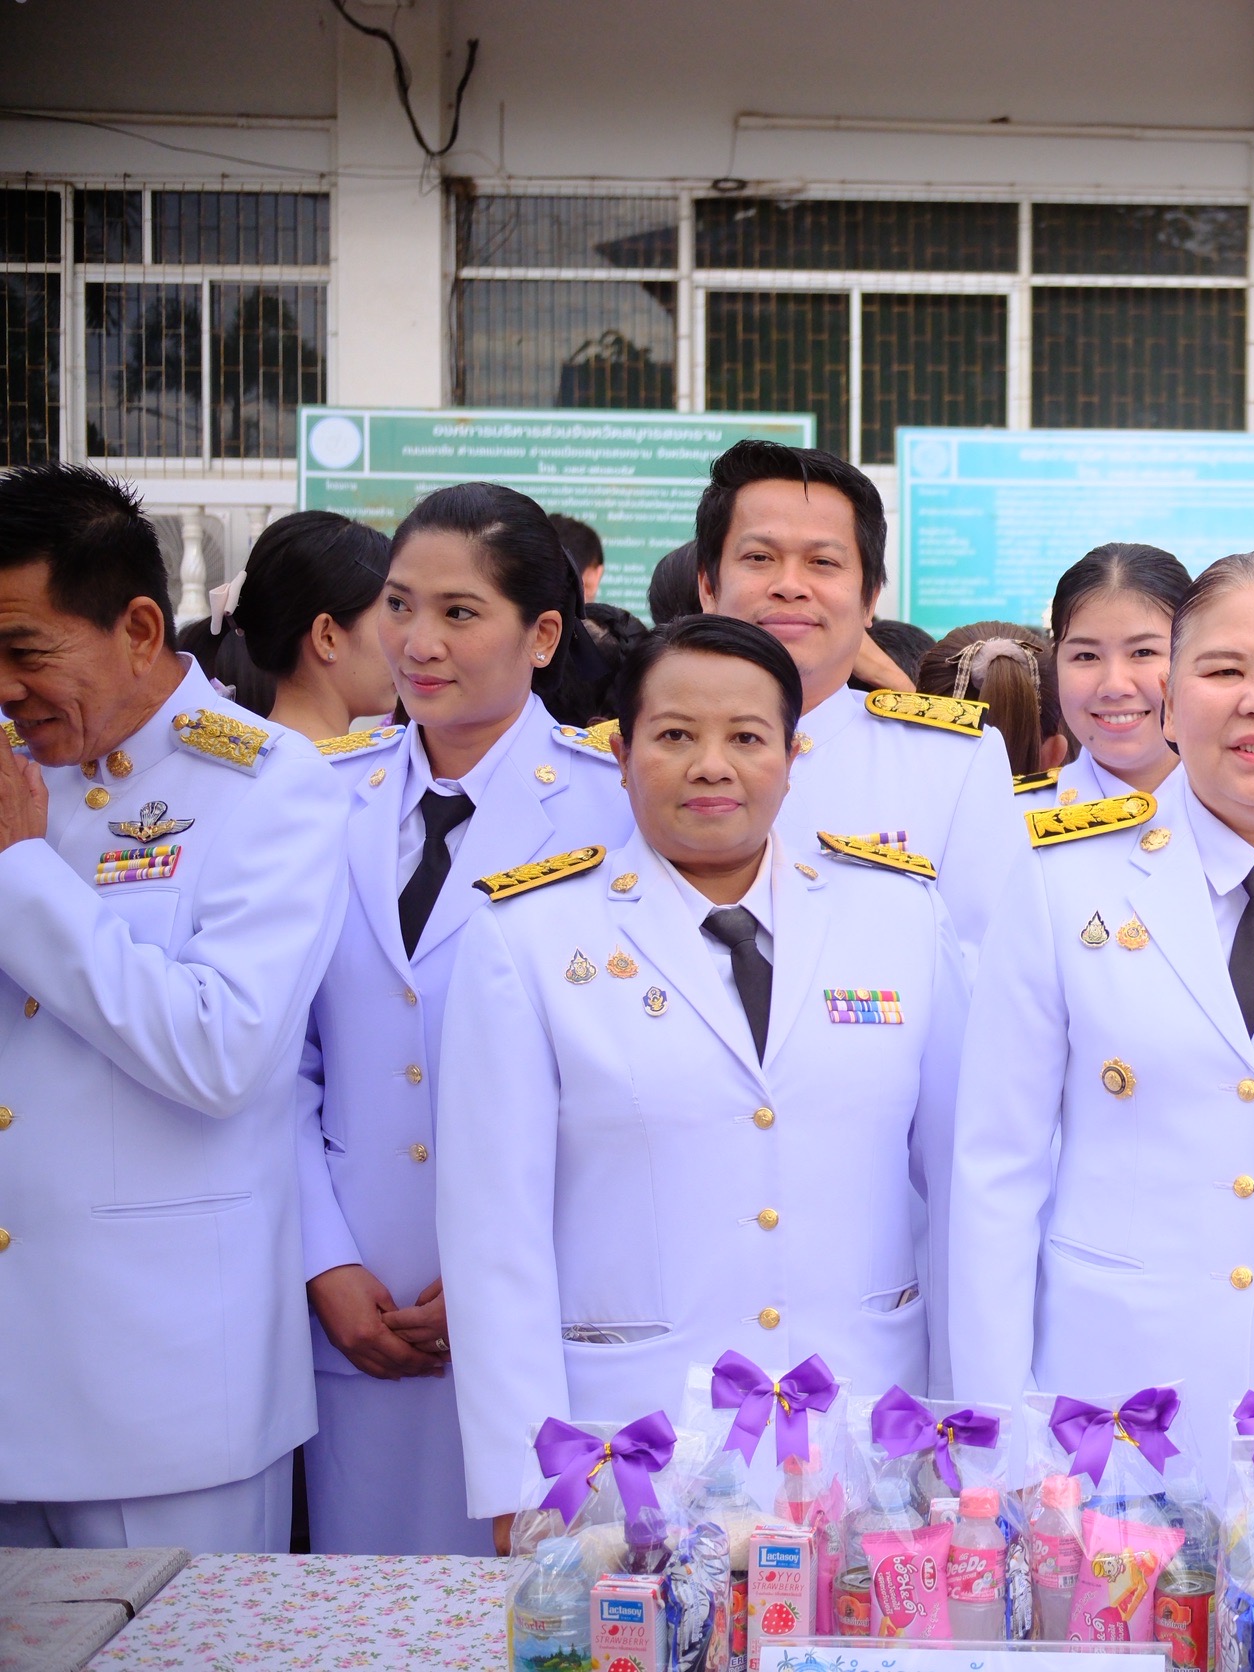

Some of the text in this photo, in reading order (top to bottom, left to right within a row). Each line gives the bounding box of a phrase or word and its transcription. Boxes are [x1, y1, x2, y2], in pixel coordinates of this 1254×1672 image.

[760, 1548, 799, 1565] Lactasoy
[752, 1582, 805, 1592] STRAWBERRY
[602, 1601, 642, 1619] Lactasoy
[594, 1635, 649, 1646] STRAWBERRY
